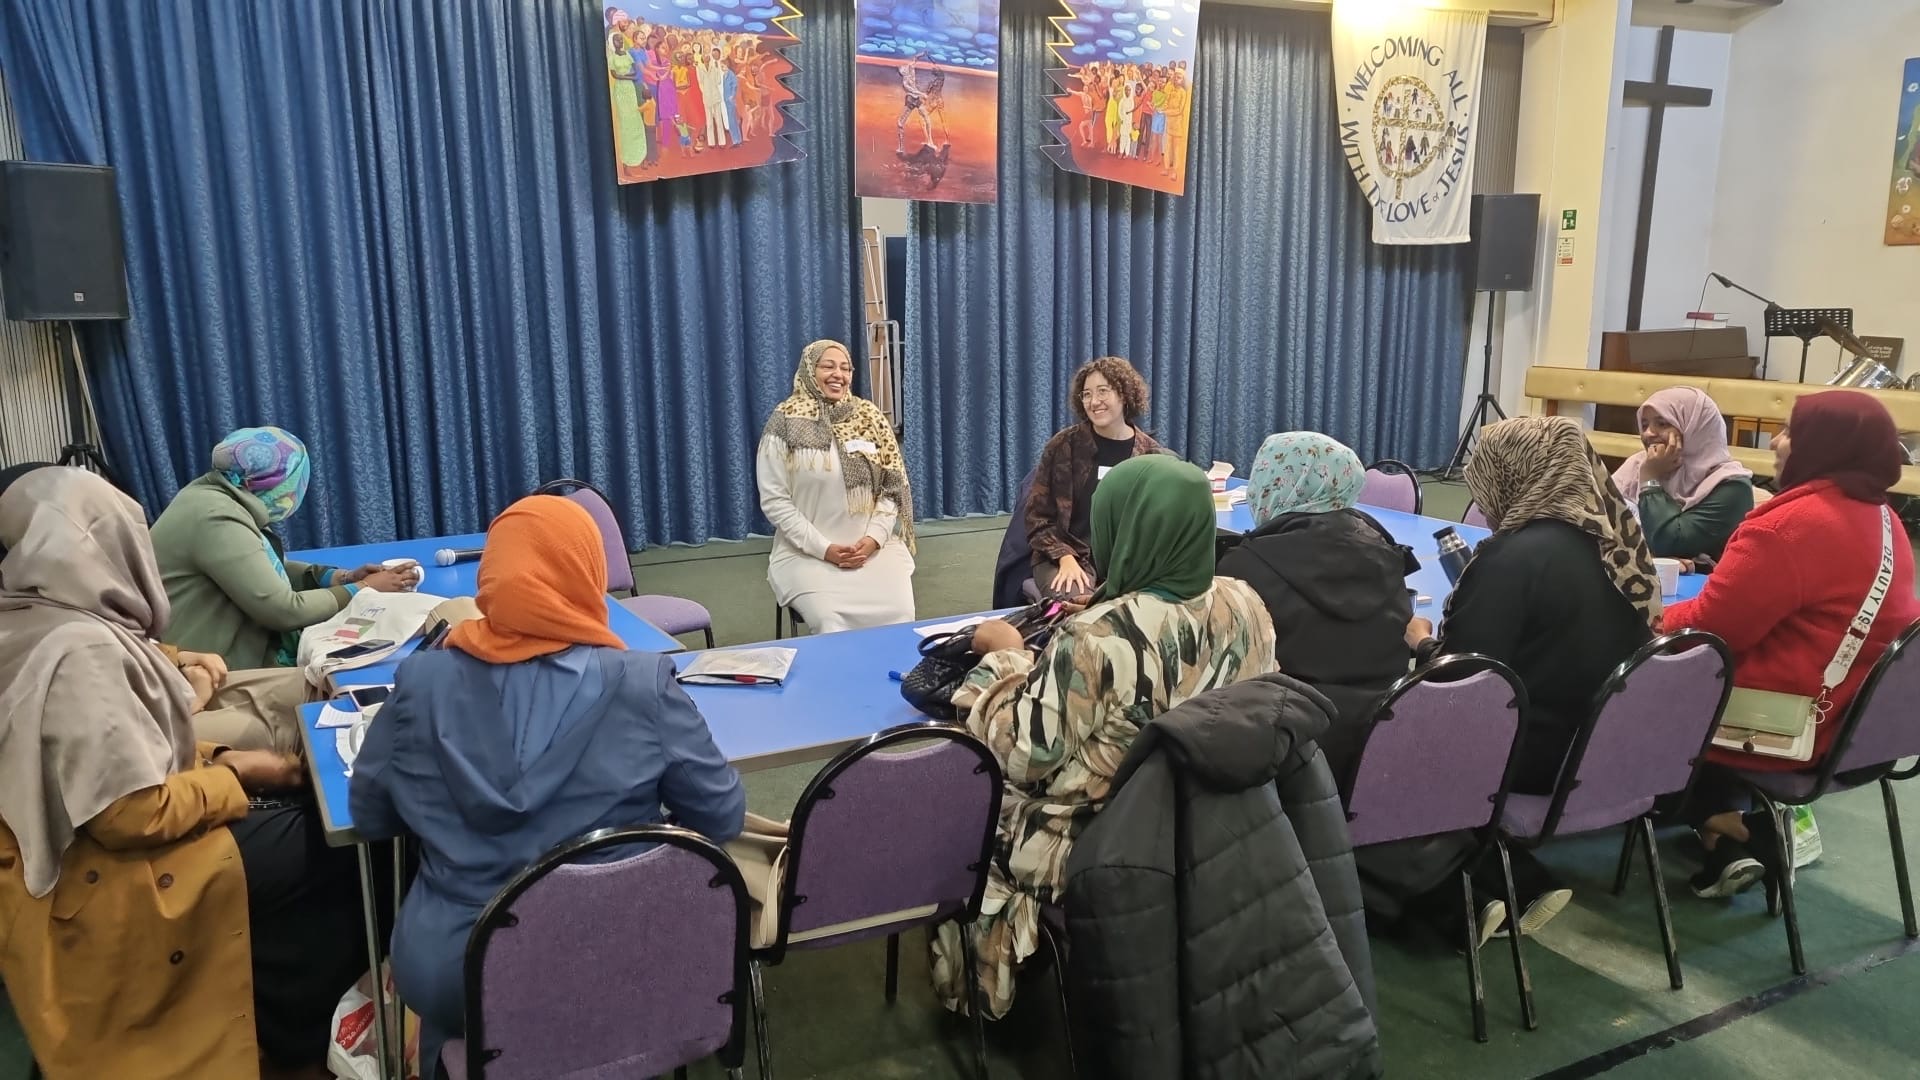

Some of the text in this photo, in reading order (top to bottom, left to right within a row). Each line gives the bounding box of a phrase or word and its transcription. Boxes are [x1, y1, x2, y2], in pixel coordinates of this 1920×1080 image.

[1345, 36, 1468, 111] WELCOMING ALL
[1341, 120, 1370, 183] WITH
[1386, 192, 1432, 222] LOVE
[1437, 124, 1469, 197] JESUS
